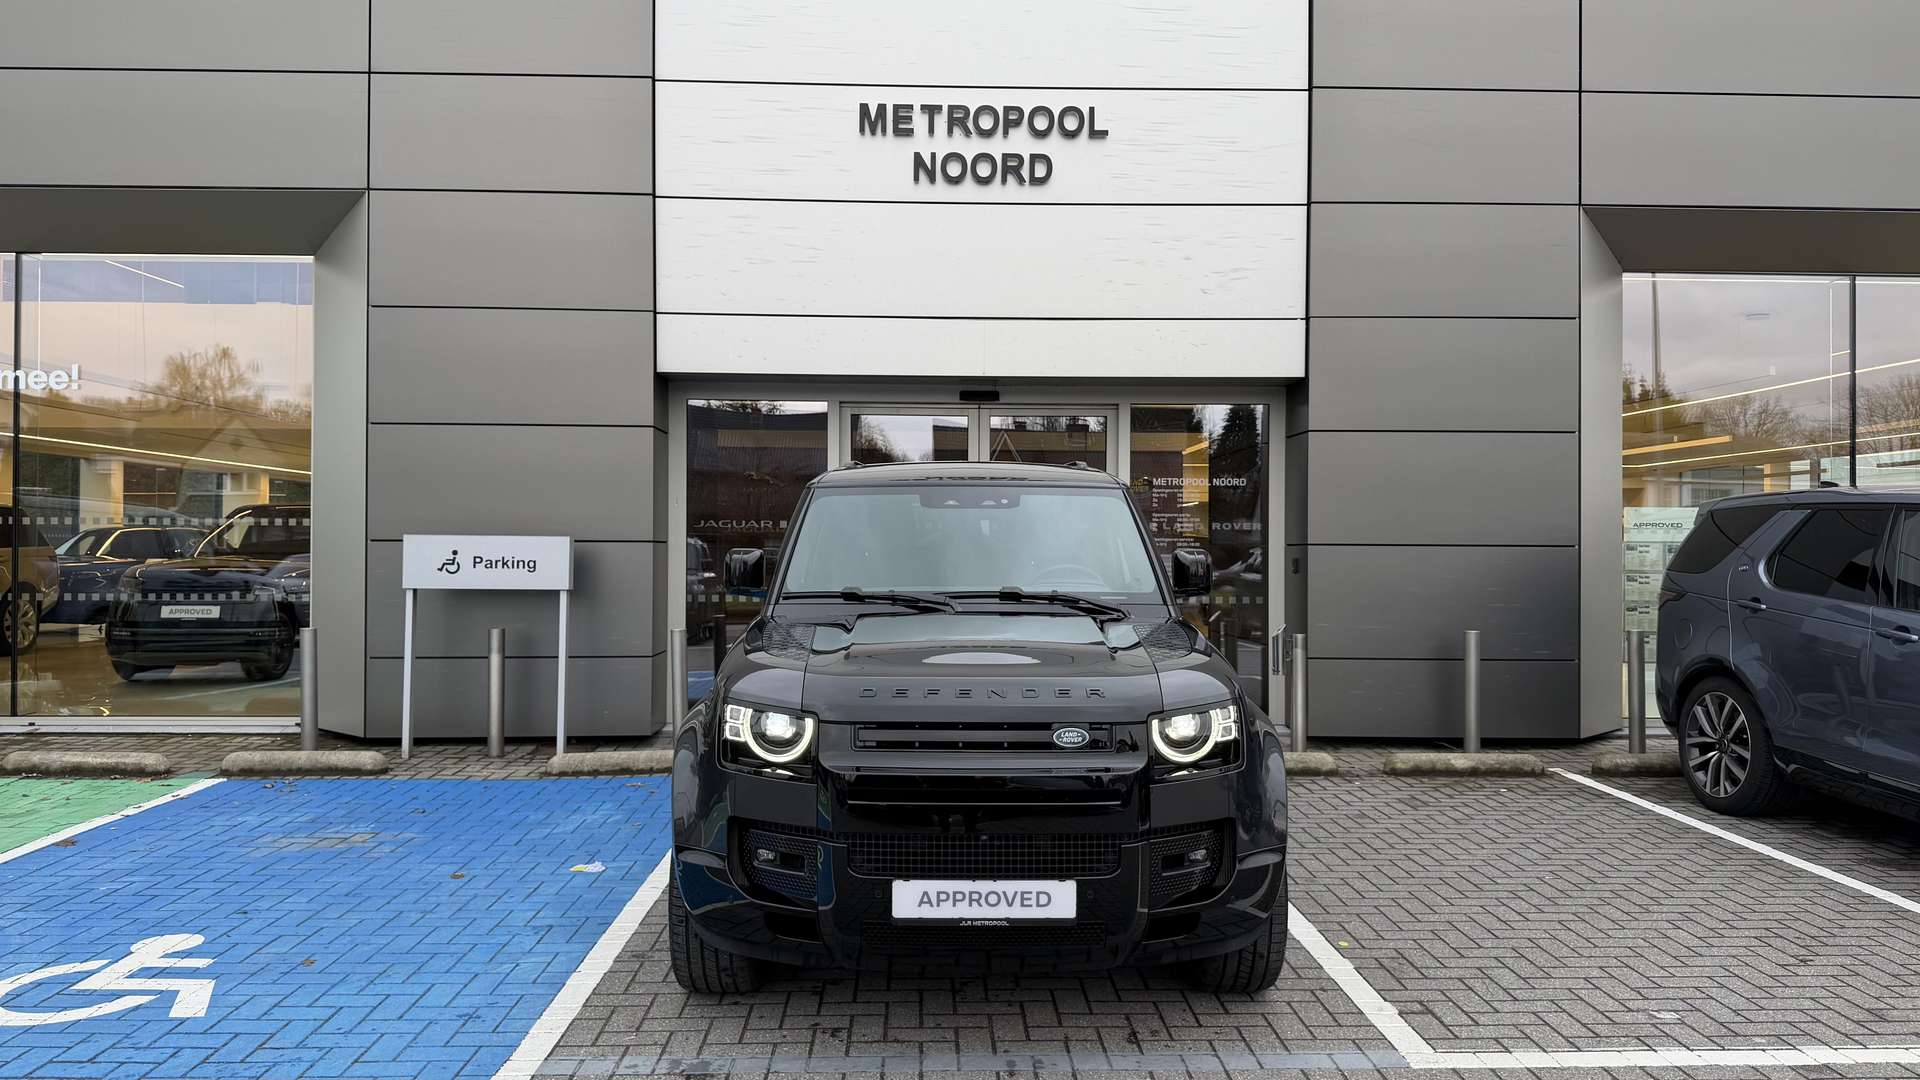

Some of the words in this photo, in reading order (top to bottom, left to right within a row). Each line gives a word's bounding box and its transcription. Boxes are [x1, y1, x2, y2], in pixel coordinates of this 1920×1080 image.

[858, 102, 1109, 139] METROPOOL
[913, 151, 1053, 186] NOORD
[1153, 478, 1211, 486] METROPOOL
[1213, 478, 1247, 486] NOORD
[694, 520, 773, 528] JAGUAR
[1212, 522, 1262, 530] ROVER
[1632, 521, 1684, 529] APPROVED
[473, 556, 537, 573] Parking
[859, 688, 1106, 699] DEFENDER
[917, 890, 1052, 908] APPROVED
